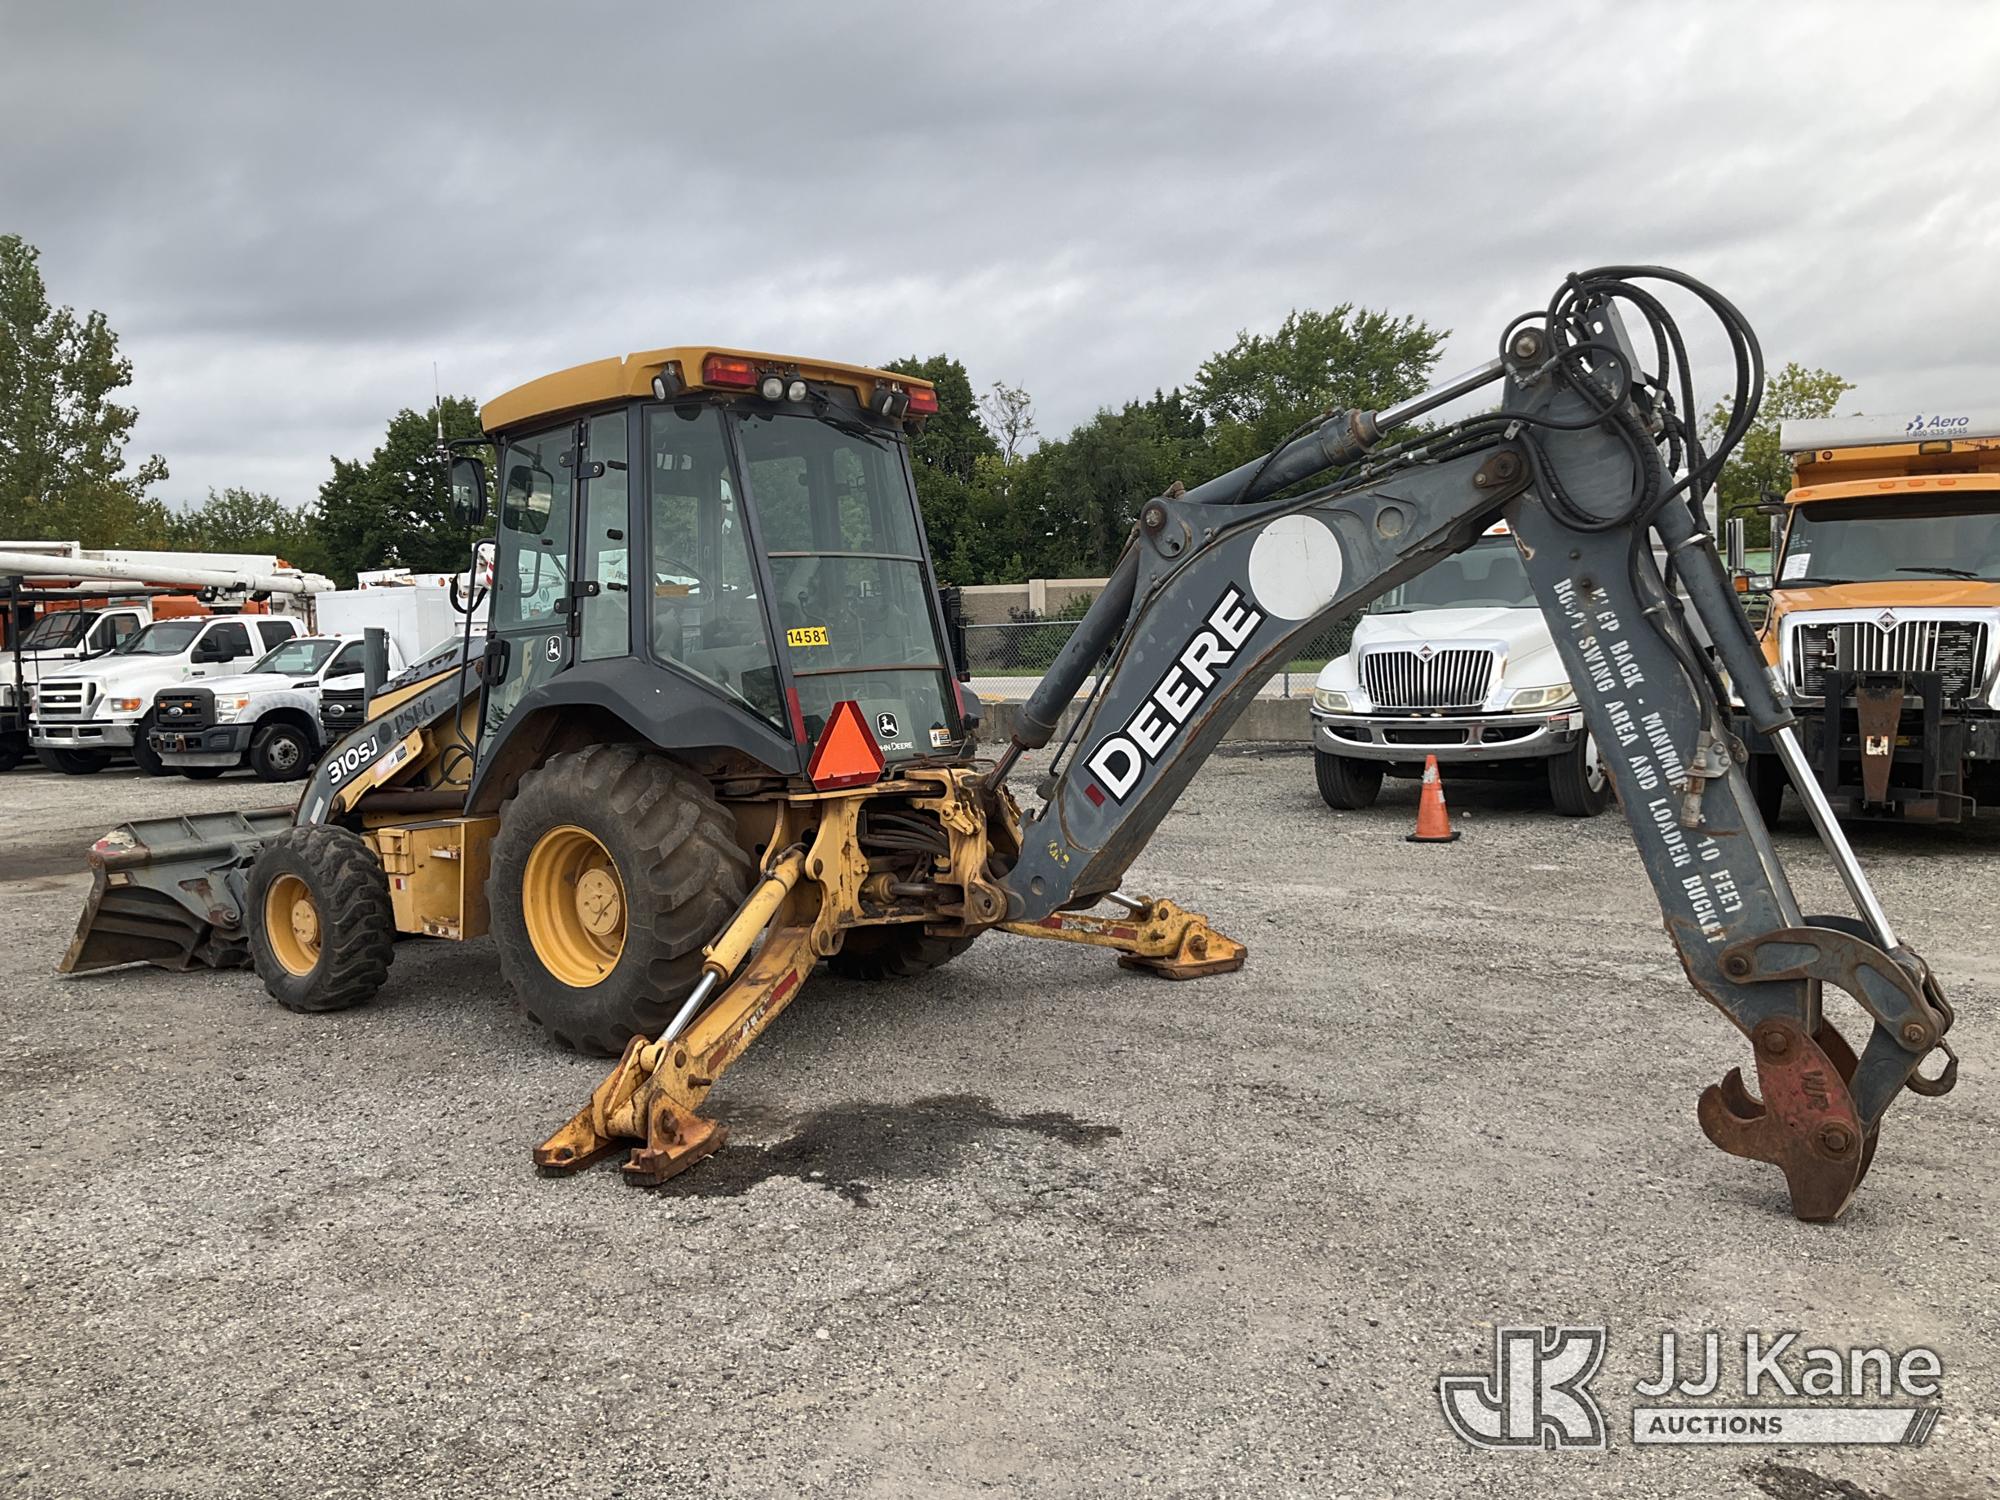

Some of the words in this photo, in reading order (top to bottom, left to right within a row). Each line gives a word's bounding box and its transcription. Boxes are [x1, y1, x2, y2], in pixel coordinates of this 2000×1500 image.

[1927, 415, 1969, 428] Aero
[787, 630, 828, 643] 14581
[394, 696, 435, 735] PSEG
[1088, 589, 1262, 800] DEERE
[327, 735, 378, 784] 310SJ
[892, 741, 913, 751] DEERE
[1591, 587, 1620, 631] KEP
[1609, 640, 1645, 689] BACK
[1697, 836, 1720, 861] 10
[1710, 869, 1743, 913] FEET
[1578, 635, 1616, 692] SWING
[1604, 700, 1639, 747] AREA
[1628, 755, 1658, 790] AND
[1648, 797, 1692, 868] LOADER
[1681, 874, 1726, 943] BUCKET
